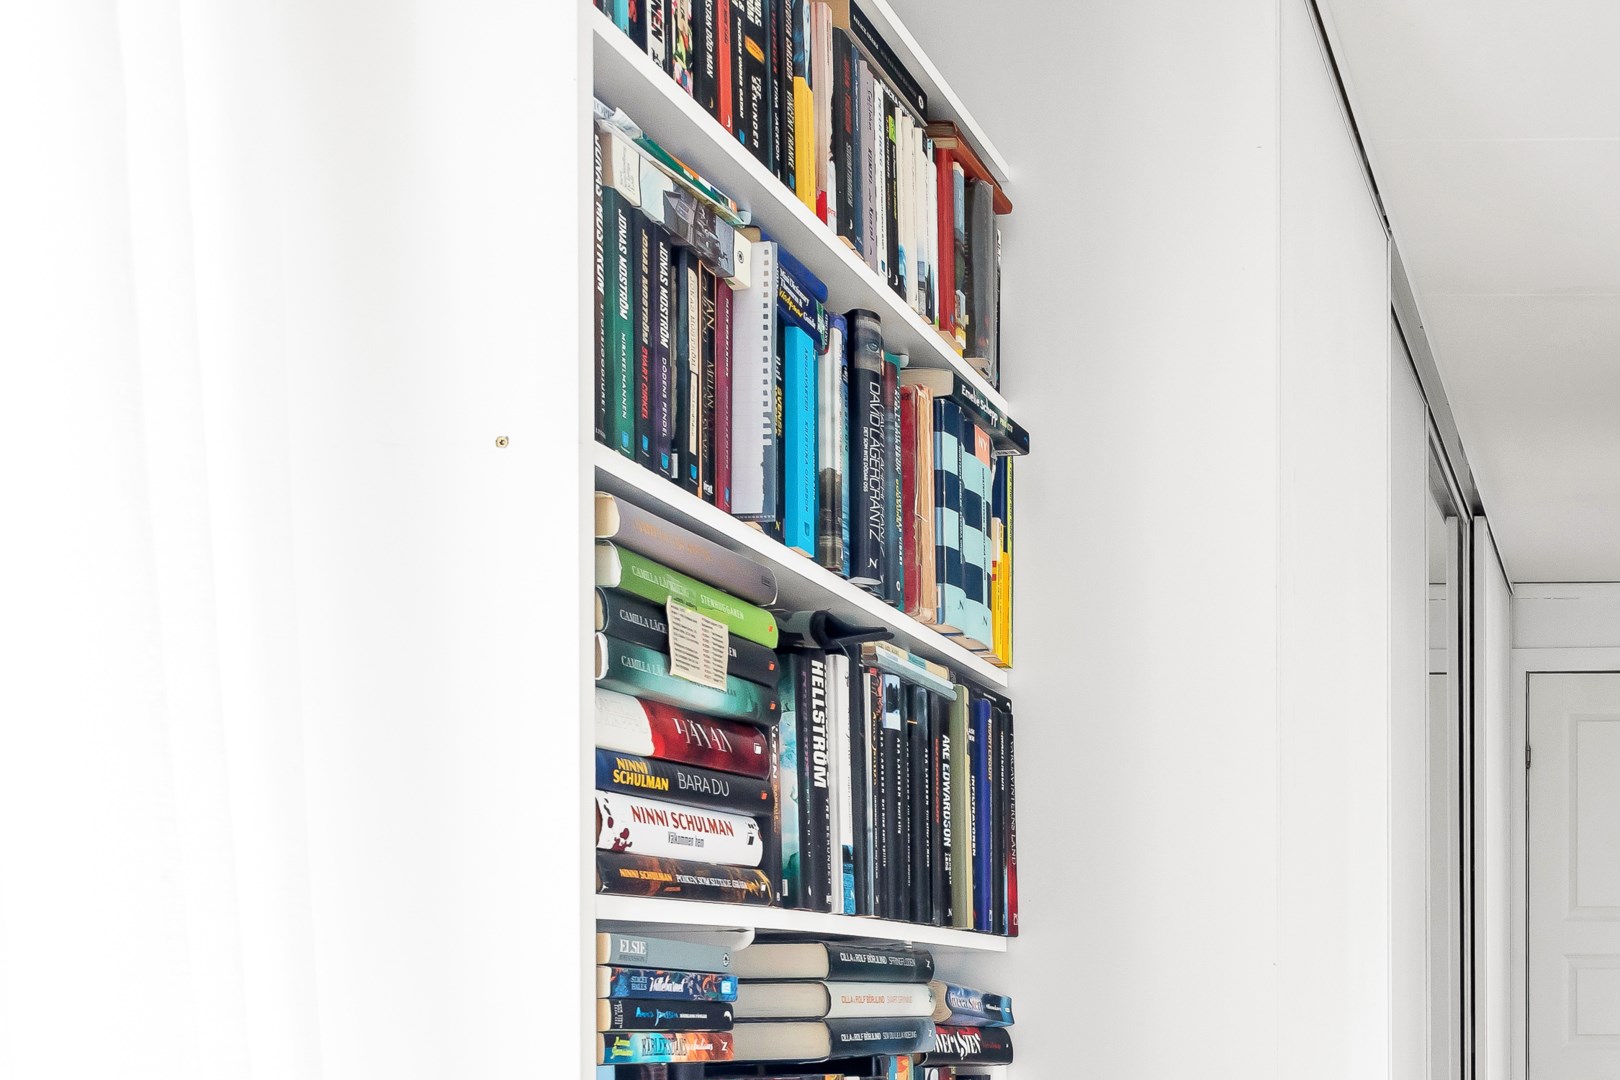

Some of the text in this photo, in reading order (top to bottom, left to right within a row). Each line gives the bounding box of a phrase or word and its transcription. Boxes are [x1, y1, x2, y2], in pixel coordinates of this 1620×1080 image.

[706, 52, 714, 78] MAN
[787, 90, 795, 133] VINCENT
[618, 209, 627, 252] JONAS
[659, 241, 668, 285] JONAS
[619, 254, 629, 321] MOSTRÖM
[659, 286, 669, 349] MOSTRÖM
[706, 298, 715, 331] JAN
[980, 398, 999, 428] Schepp
[869, 381, 881, 543] DAVID LAGERCRANTZ
[631, 565, 745, 620] CAMILLA STENHUGGAREN
[619, 609, 650, 628] CAMILLA
[620, 655, 651, 674] CAMILLA
[811, 659, 828, 788] HELLSTRÖM
[615, 757, 649, 775] NINNI
[613, 769, 730, 797] SCHULMAN BARA DU
[943, 763, 951, 847] EDWARDSON
[630, 805, 735, 837] NINNI SCHULMAN
[619, 868, 673, 882] NINNI SCHULMAN
[698, 875, 710, 886] SOM
[619, 938, 647, 955] ELSIE
[839, 952, 854, 962] CILLA
[856, 954, 868, 963] ROLF
[841, 1033, 854, 1042] CILLA
